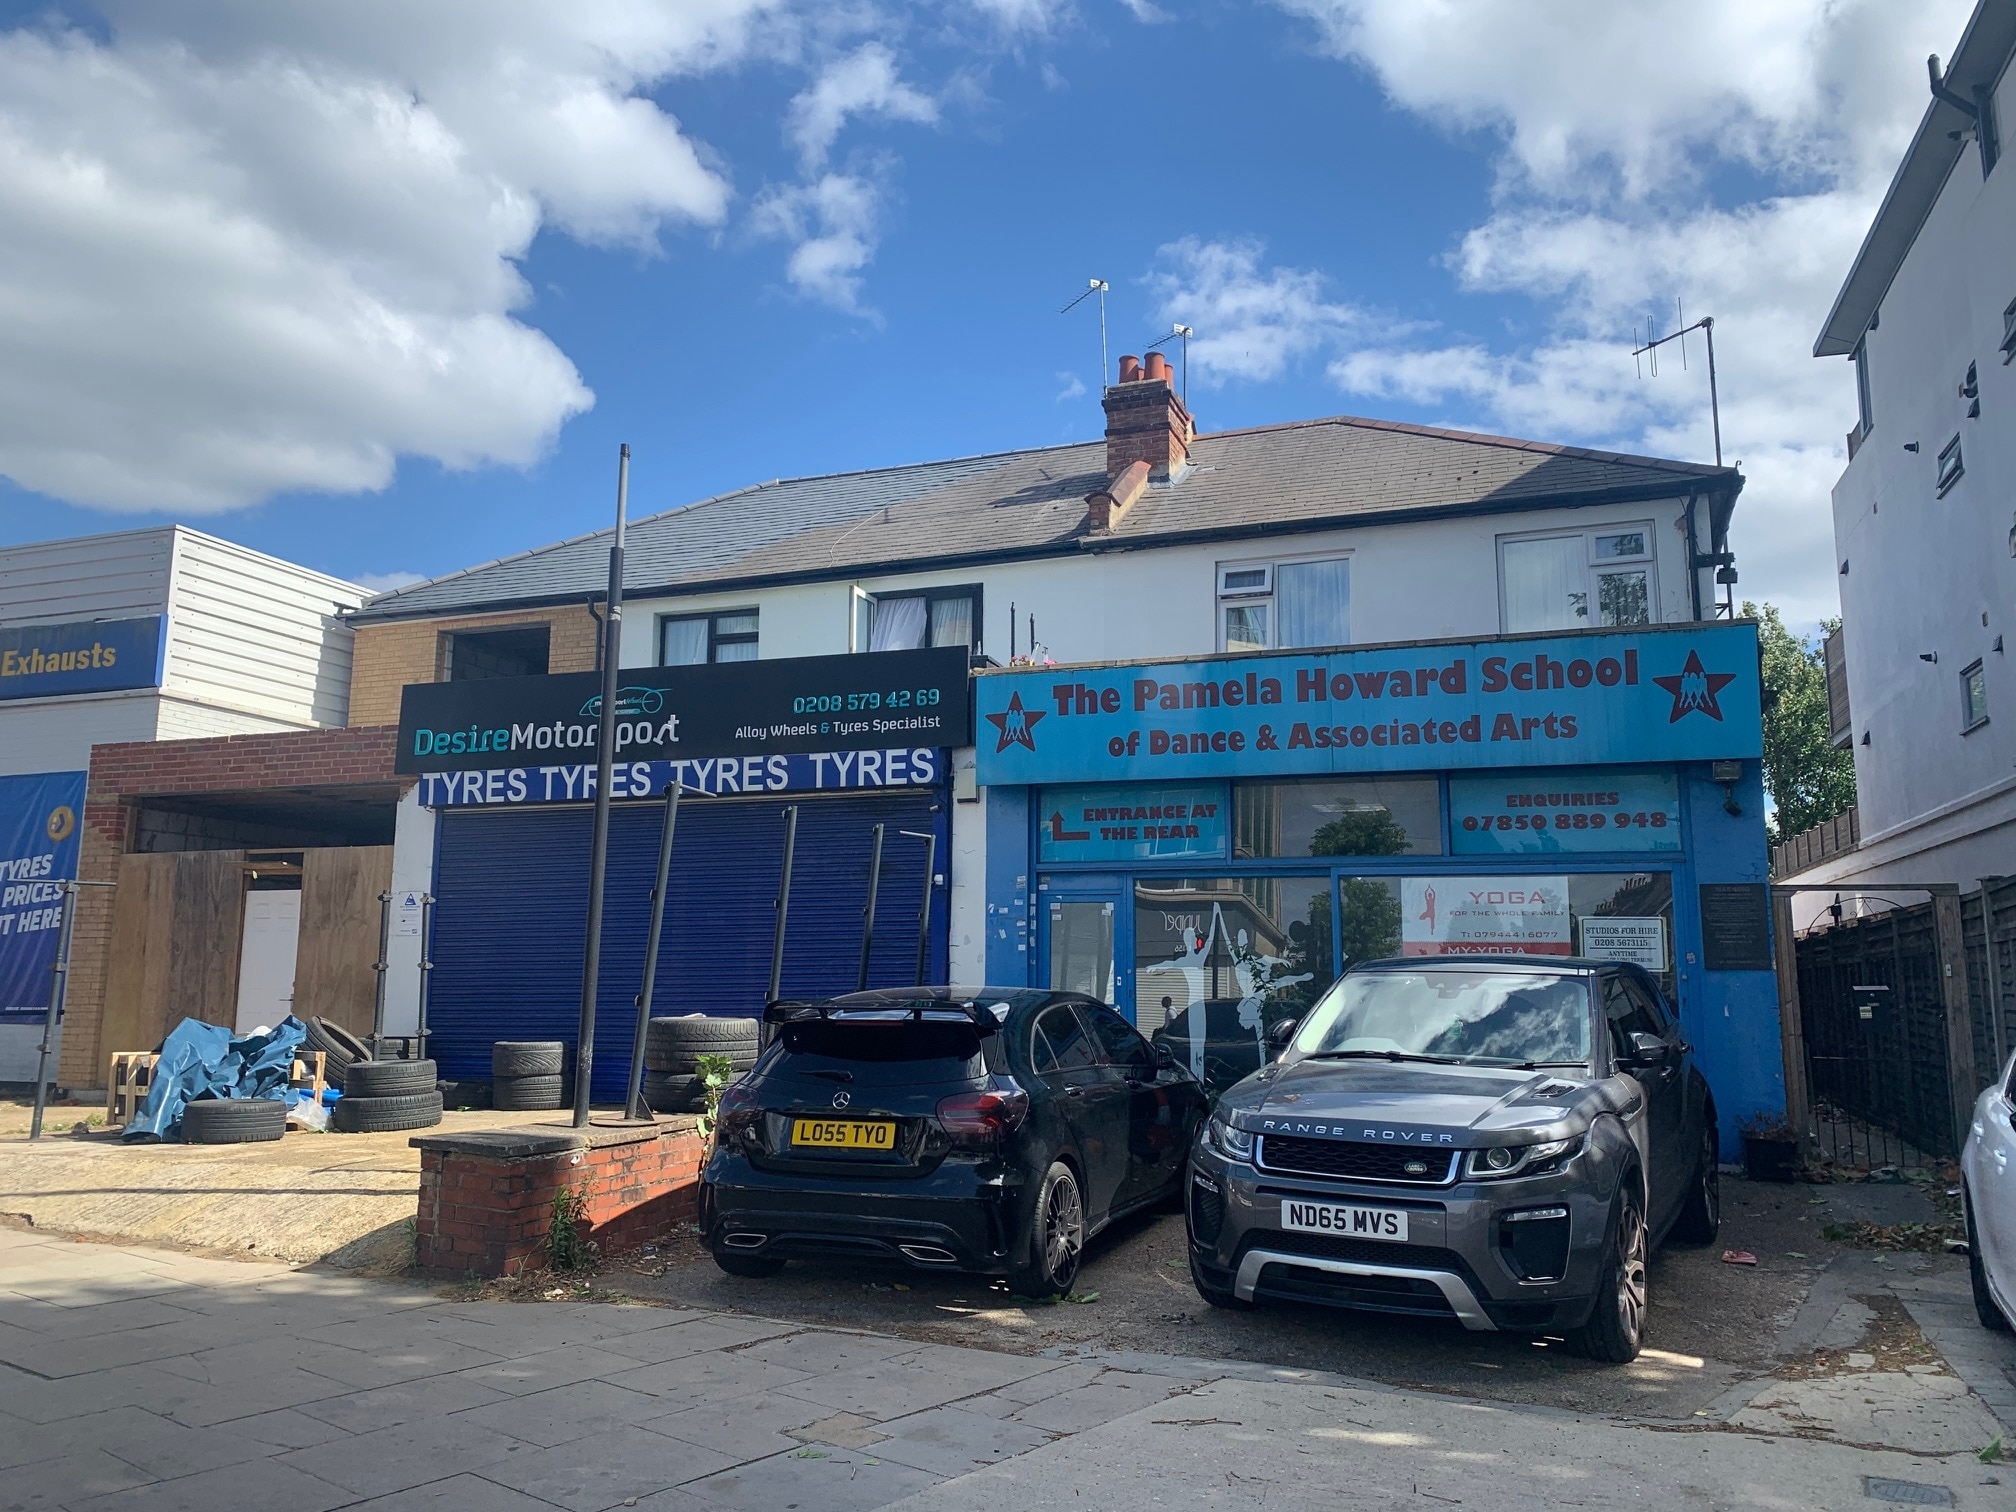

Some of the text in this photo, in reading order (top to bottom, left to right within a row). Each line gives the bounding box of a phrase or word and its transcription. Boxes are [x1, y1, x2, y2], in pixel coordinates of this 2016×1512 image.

[1, 642, 116, 677] Exhausts
[1052, 648, 1639, 716] The Pamela Howard School
[793, 688, 940, 714] 0208 579 42 69
[414, 713, 681, 756] DesireMotorport
[735, 715, 941, 740] Alloy Wheels & Tyres Specialist
[1108, 711, 1578, 757] of Dance & Associated Arts
[422, 747, 934, 806] TYRES TYRES TYRES TYRES
[1083, 804, 1218, 822] ENTRANCE AT
[1506, 792, 1620, 808] ENQUIRIES
[1100, 825, 1200, 841] THE REAR
[1462, 812, 1667, 832] 07850 889 948
[0, 854, 53, 881] TYRES
[1, 882, 65, 908] PRICES
[1468, 891, 1546, 905] YOGA
[16, 906, 62, 934] HERE
[1585, 926, 1659, 935] STUDIOS FOR HIRE
[1594, 939, 1648, 947] 0208 5673115
[1263, 1119, 1455, 1144] RANGE ROVER
[1289, 1202, 1399, 1236] ND65 MVS
